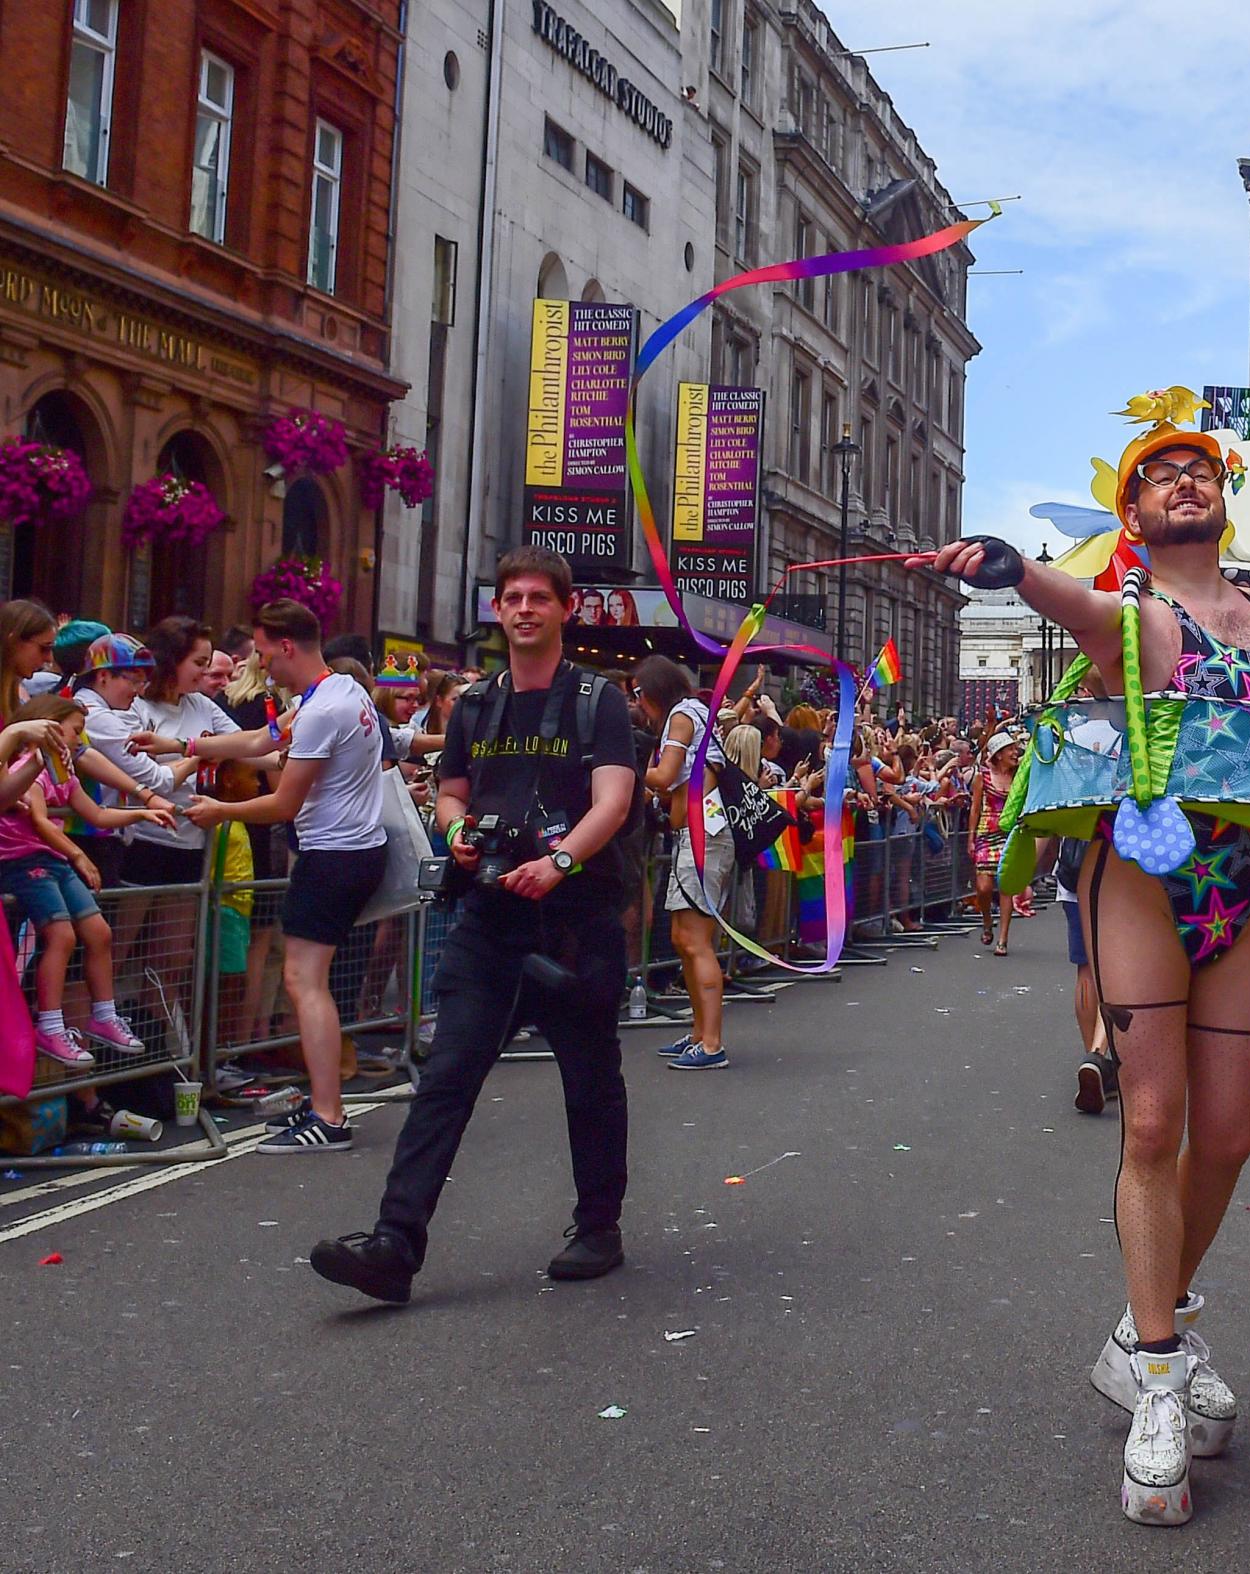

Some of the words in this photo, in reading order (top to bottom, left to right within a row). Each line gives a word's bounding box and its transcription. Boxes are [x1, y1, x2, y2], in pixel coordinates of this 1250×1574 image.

[531, 0, 620, 110] TRAFALGAR
[617, 77, 673, 149] STUDIOS
[574, 308, 593, 320] THE
[594, 308, 632, 319] CLASSIC
[573, 321, 591, 331] HIT
[592, 320, 631, 331] COMEDY
[573, 337, 599, 347] MATT
[600, 336, 628, 346] BERRY
[572, 351, 603, 361] SIMON
[603, 350, 626, 360] BIRD
[528, 303, 568, 447] Philanthropist
[572, 365, 593, 375] LILY
[593, 364, 617, 375] COLE
[571, 379, 627, 390] CHARLOTTE
[571, 391, 608, 401] RITCHIE
[713, 391, 729, 400] THE
[730, 391, 760, 401] CLASSIC
[570, 405, 591, 415] TOM
[712, 401, 725, 411] HIT
[727, 401, 759, 410] COMEDY
[570, 416, 625, 428] ROSENTHAL
[711, 415, 733, 424] MATT
[734, 414, 758, 423] BERRY
[710, 427, 735, 435] SIMON
[735, 426, 755, 435] BIRD
[568, 438, 624, 448] CHRISTOPHER
[675, 387, 708, 507] Philanthropist
[710, 439, 728, 448] LILY
[727, 438, 747, 447] COLE
[568, 448, 607, 458] HAMPTON
[709, 450, 755, 460] CHARLOTTE
[534, 451, 557, 475] the
[709, 460, 740, 469] RITCHIE
[567, 466, 593, 476] SIMON
[593, 465, 625, 475] CALLOW
[709, 472, 726, 481] TOM
[708, 482, 753, 491] ROSENTHAL
[707, 499, 754, 509] CHRISTOPHER
[532, 506, 578, 523] KISS
[586, 509, 616, 525] ME
[707, 508, 739, 517] HAMPTON
[679, 510, 698, 531] the
[706, 523, 729, 532] SIMON
[729, 522, 754, 531] CALLOW
[531, 531, 575, 554] DISCO
[581, 533, 616, 556] PIGS
[678, 556, 716, 571] KISS
[722, 559, 747, 573] ME
[677, 577, 714, 598] DISCO
[719, 579, 747, 599] PIGS
[525, 736, 568, 754] LOON
